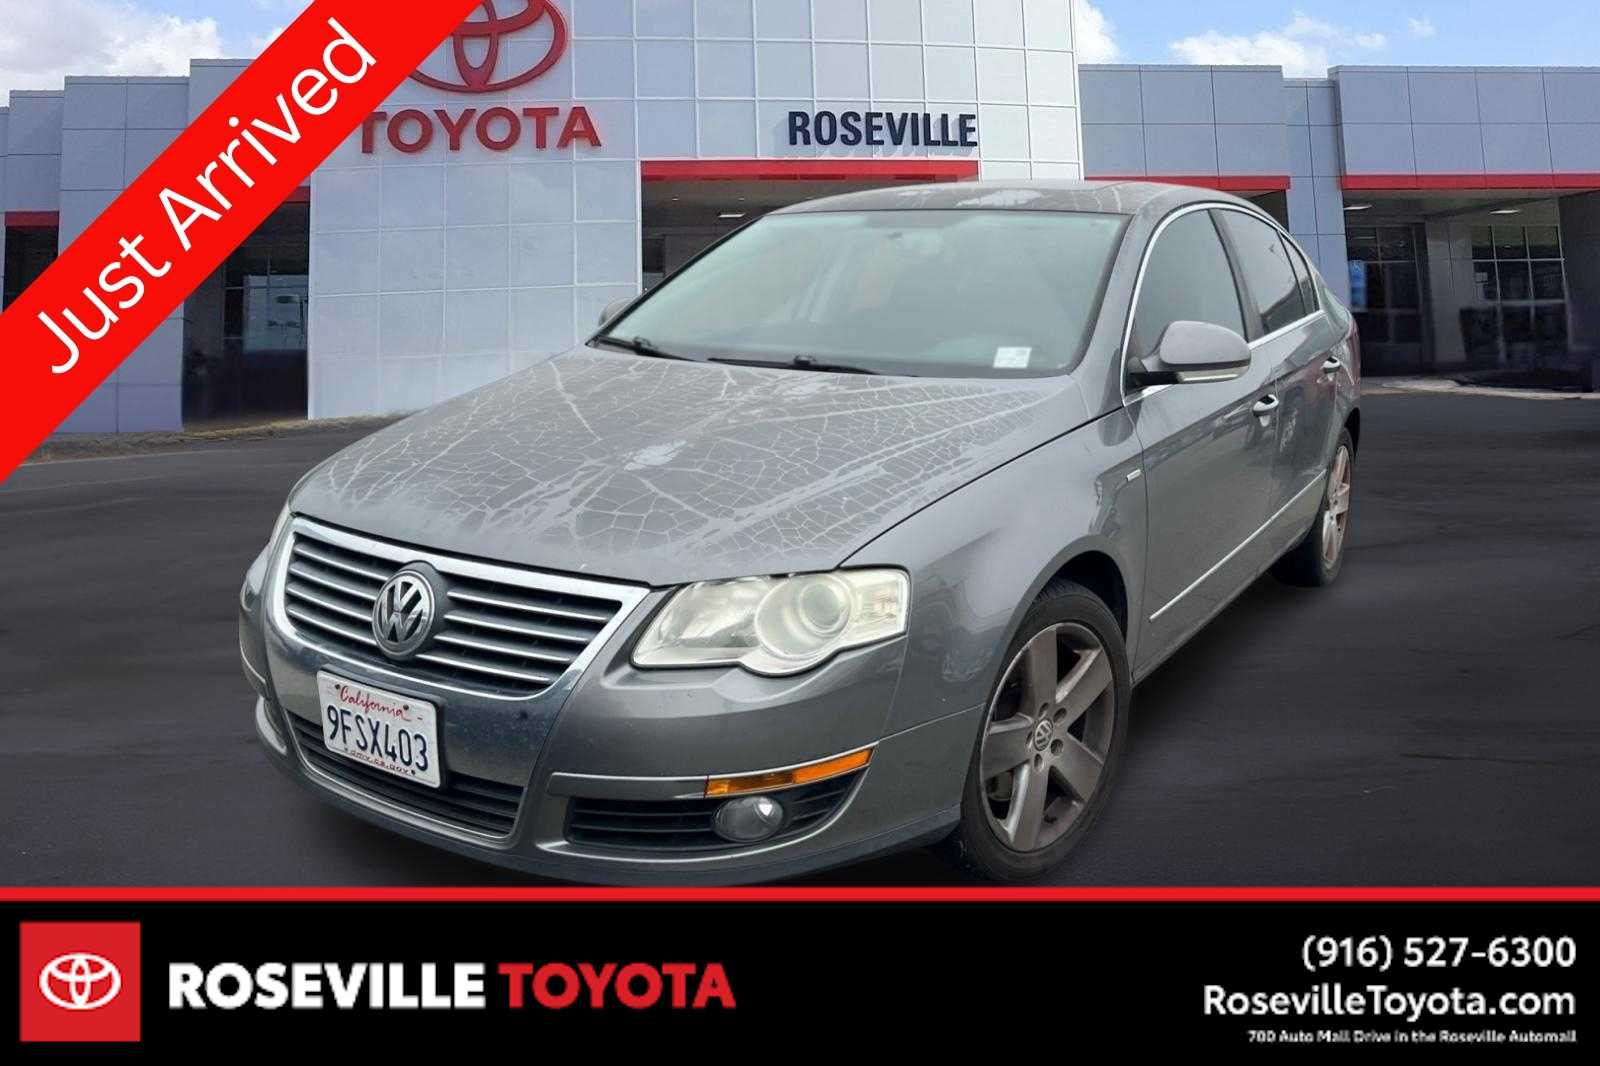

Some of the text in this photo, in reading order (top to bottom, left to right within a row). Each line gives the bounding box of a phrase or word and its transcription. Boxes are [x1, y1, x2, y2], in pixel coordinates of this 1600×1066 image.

[361, 106, 602, 154] TOYOTA
[788, 110, 978, 147] ROSEVILLE
[339, 685, 412, 722] California
[327, 704, 429, 772] 9FSX403
